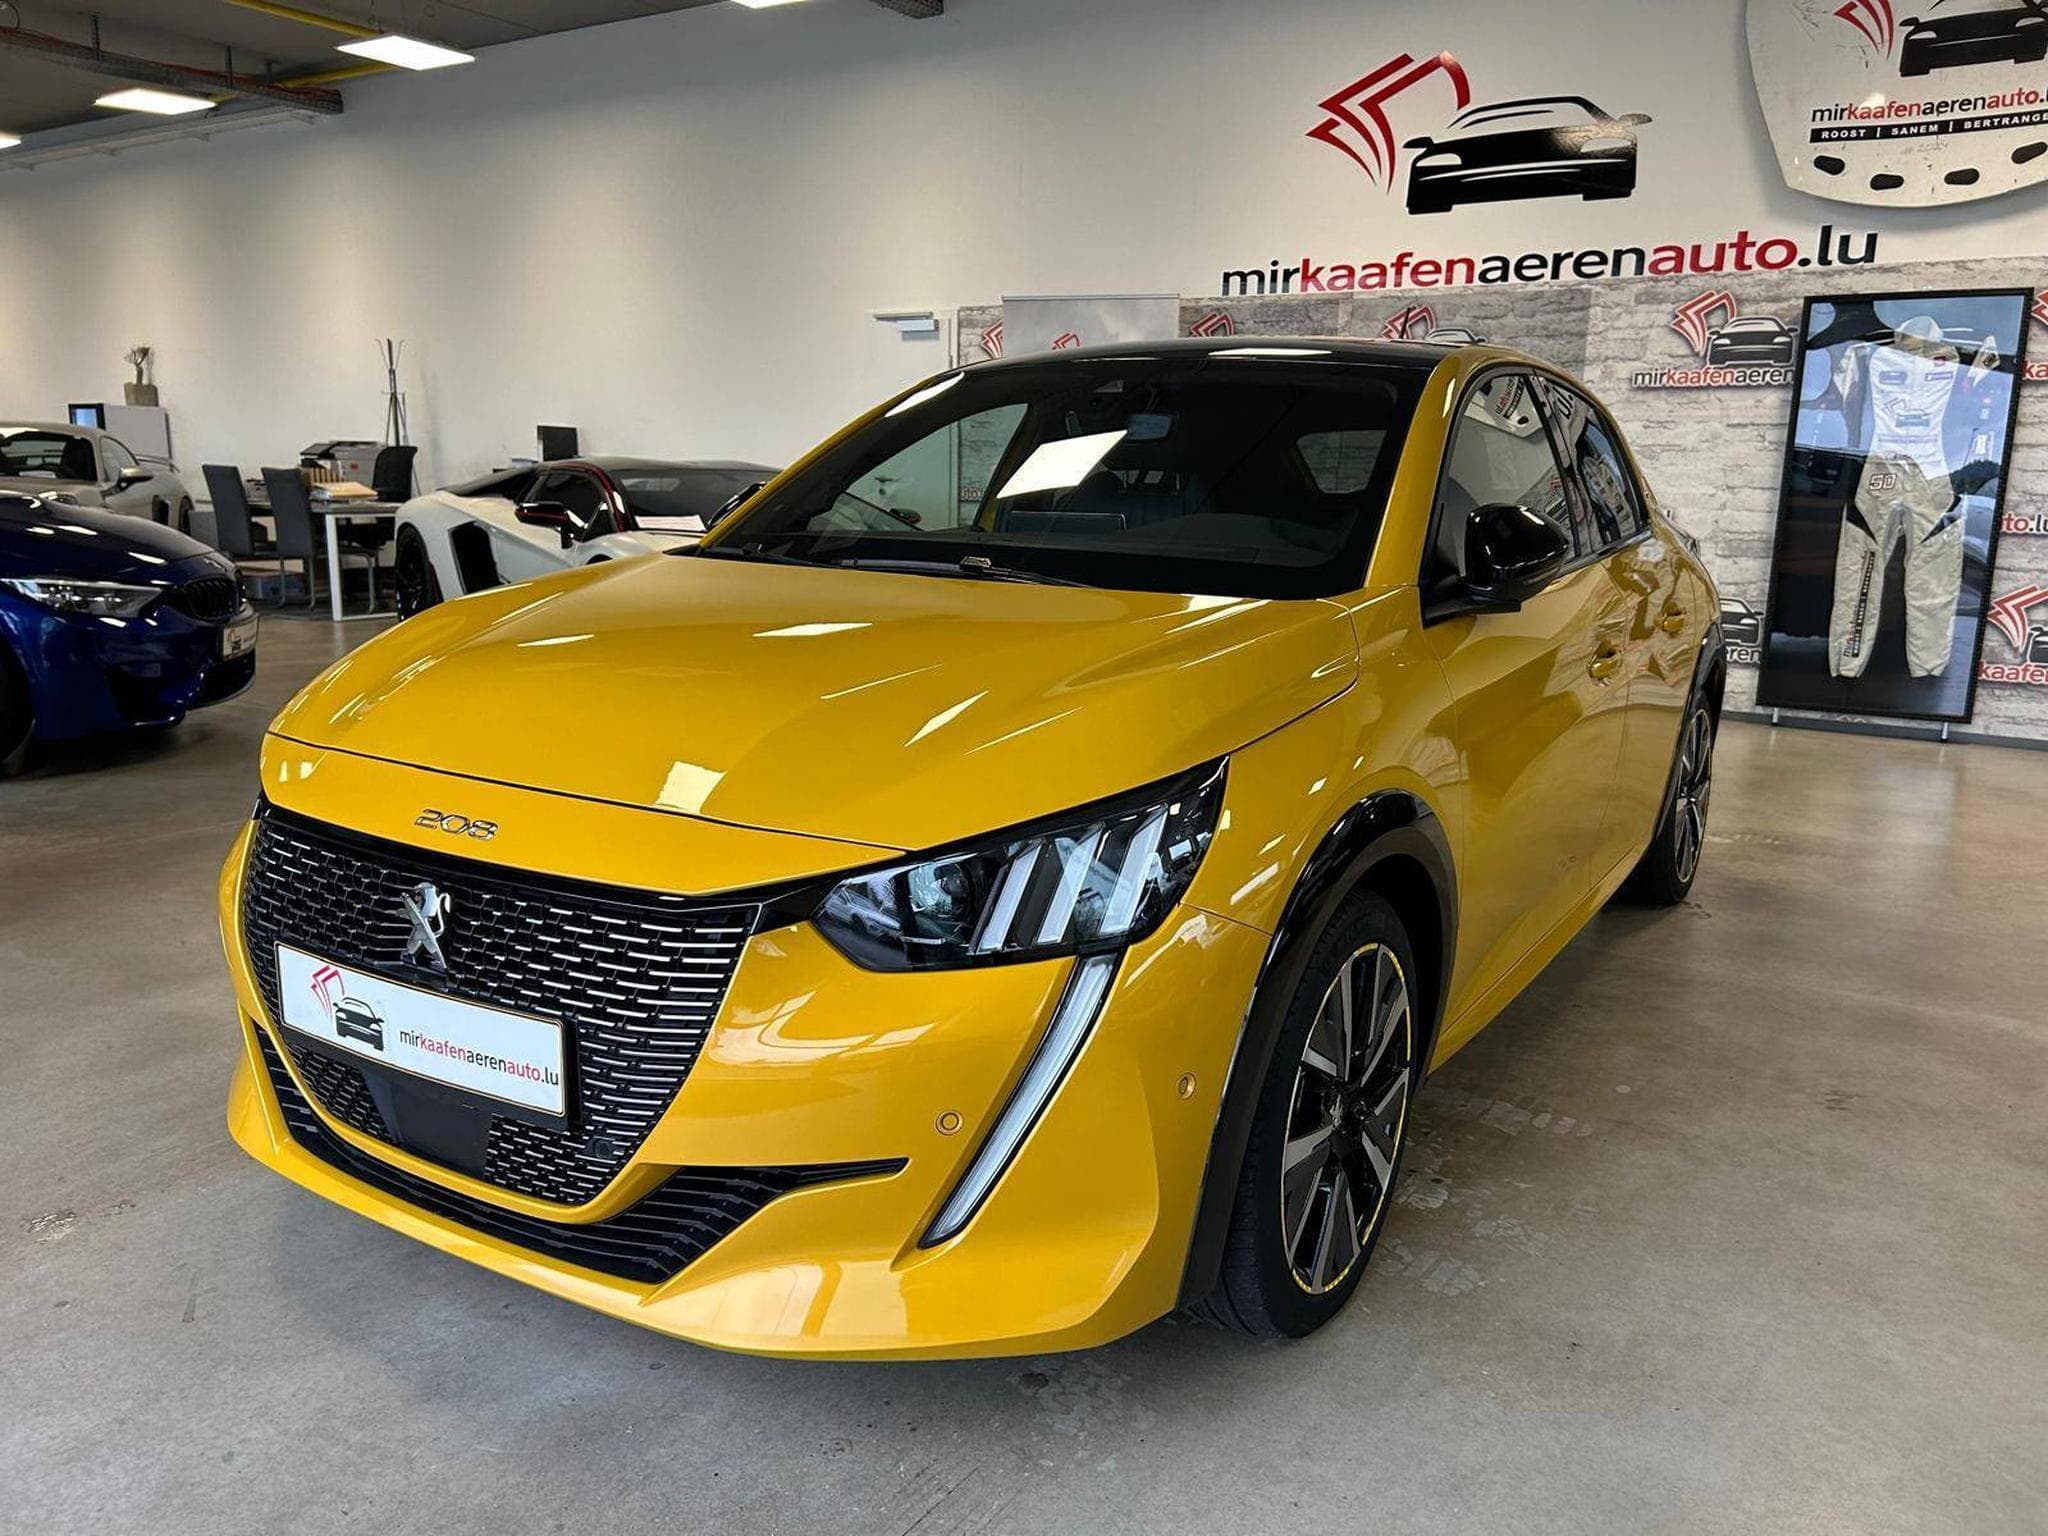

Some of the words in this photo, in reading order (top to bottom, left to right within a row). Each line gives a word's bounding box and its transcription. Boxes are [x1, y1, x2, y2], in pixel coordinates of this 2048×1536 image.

[1821, 129, 1866, 139] ROOST
[1891, 124, 1938, 135] SANEM
[1963, 113, 2048, 129] BERTRANGE
[1222, 225, 1878, 296] mirkaafenaerenauto.lu
[1870, 473, 1897, 490] 50
[1977, 661, 2048, 682] kaafe
[415, 809, 498, 840] 208
[400, 1031, 558, 1086] mirkaafenaerenauto.lu
